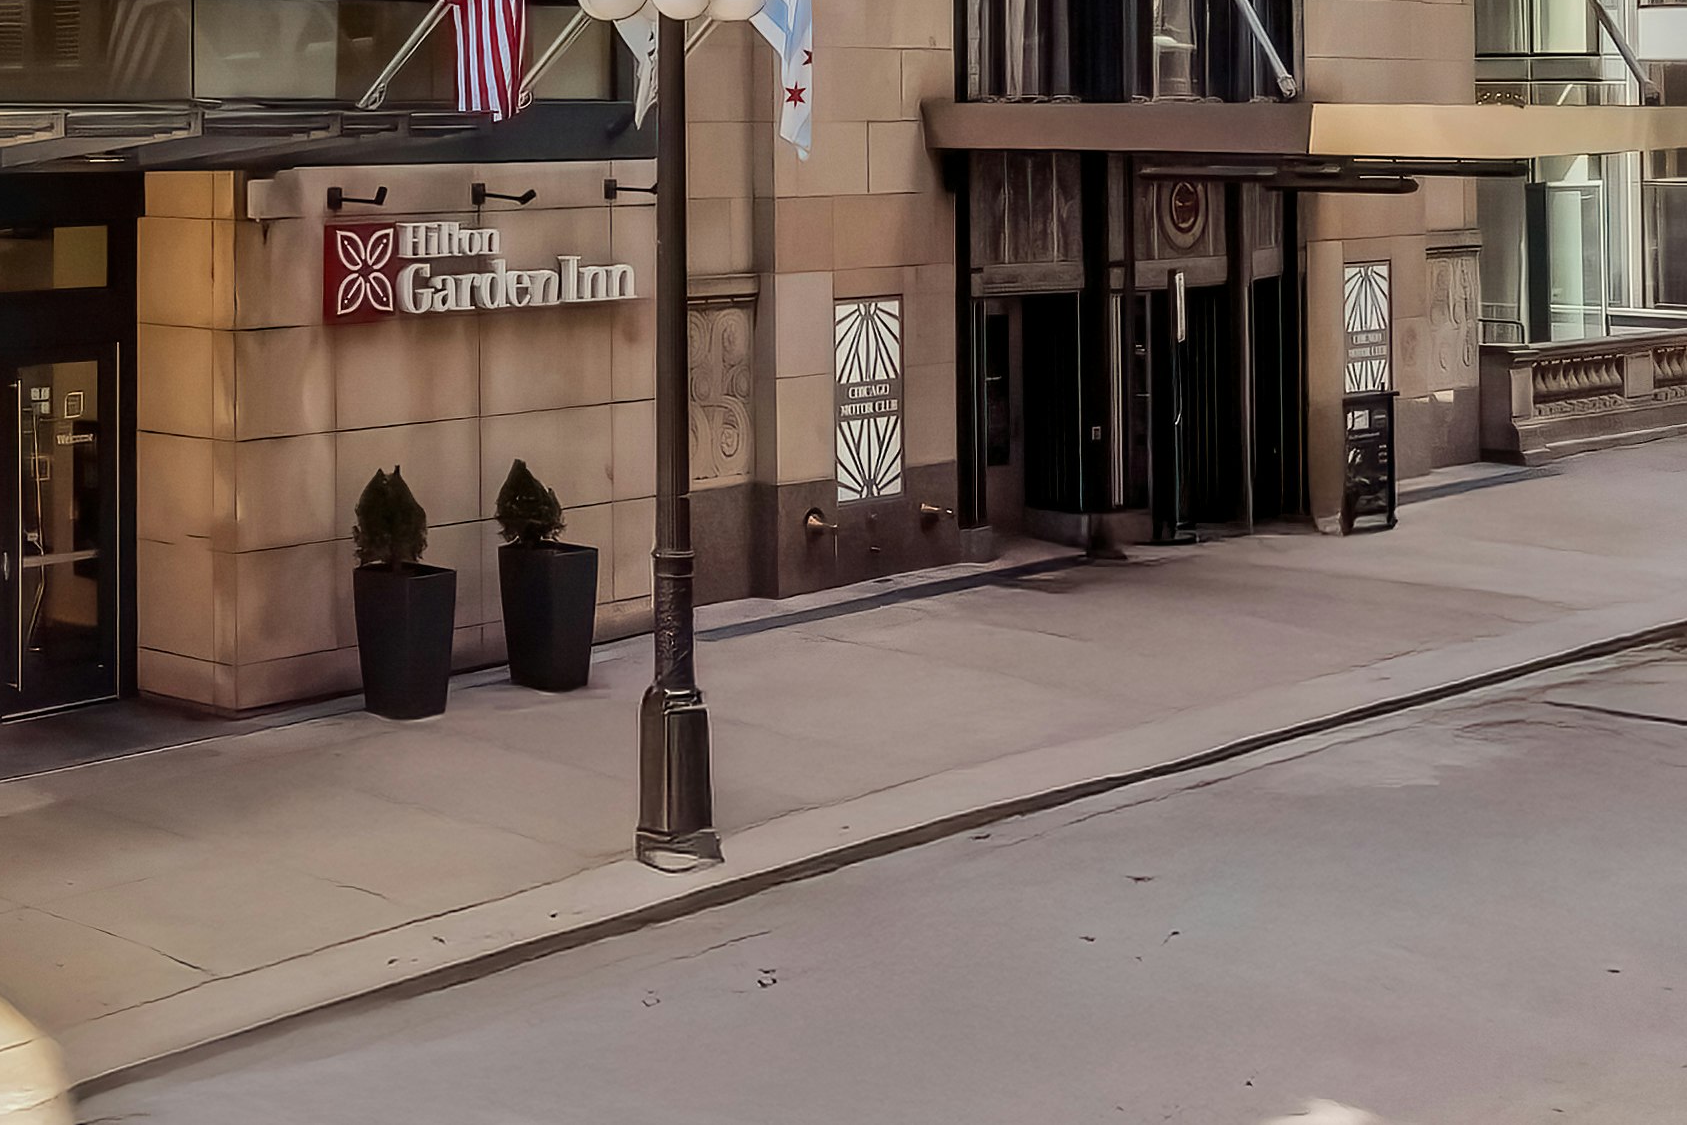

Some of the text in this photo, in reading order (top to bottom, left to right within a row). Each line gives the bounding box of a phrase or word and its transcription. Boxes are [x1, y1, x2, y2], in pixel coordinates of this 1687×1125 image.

[395, 221, 501, 258] Hilton
[849, 384, 889, 398] CHICAGO
[840, 401, 874, 417] MOTOR
